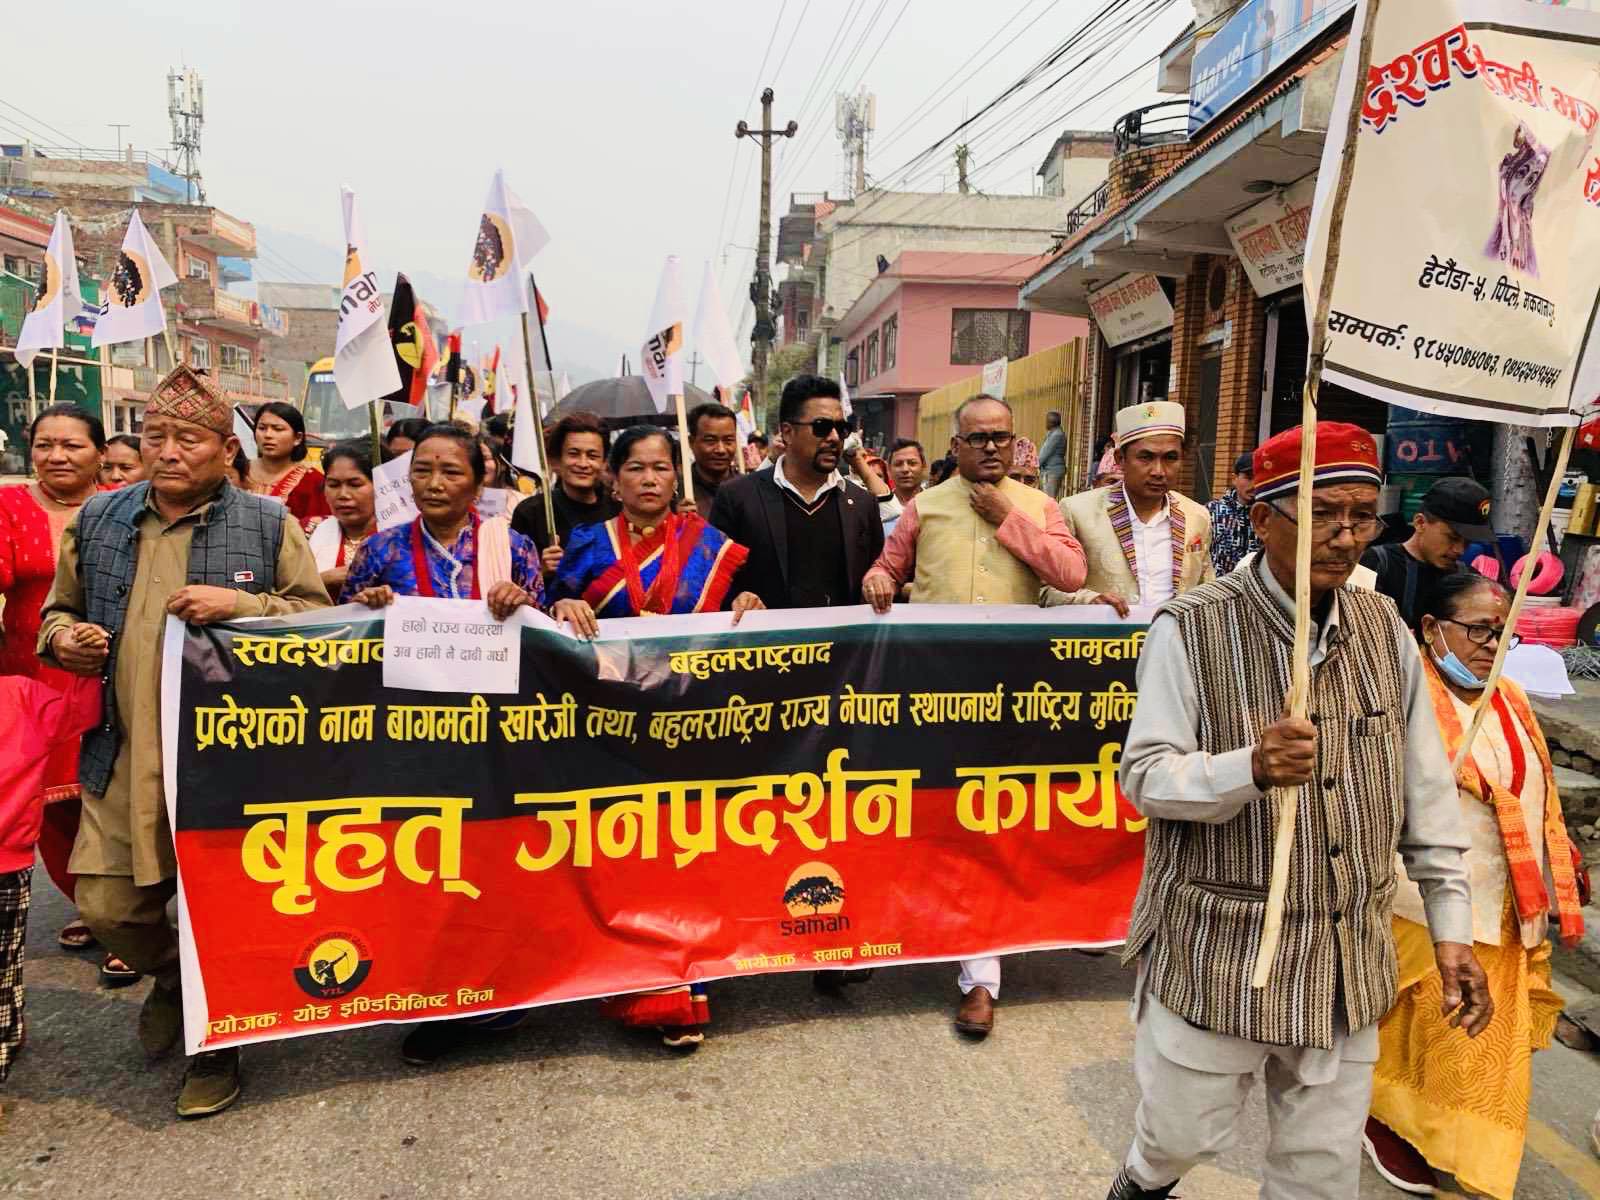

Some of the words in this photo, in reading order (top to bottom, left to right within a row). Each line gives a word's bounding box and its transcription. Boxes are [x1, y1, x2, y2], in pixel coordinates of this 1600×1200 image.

[195, 694, 308, 751] प्रदेशको
[319, 704, 376, 742] नाम
[386, 694, 490, 745] बागमती
[499, 692, 578, 743] खारेजी
[586, 705, 638, 744] तथा,
[780, 695, 831, 731] राज्य
[839, 684, 901, 727] नेपाल
[910, 684, 1004, 727] स्थापनार्थ
[1012, 681, 1083, 730] राष्ट्रिय
[241, 796, 482, 915] बृहत्
[514, 745, 921, 872] जनप्रदर्शन
[955, 742, 1149, 834] कार्य
[780, 915, 850, 937] saman
[813, 947, 854, 963] समान
[859, 942, 902, 958] नेपाल
[206, 1012, 282, 1037] योजक:
